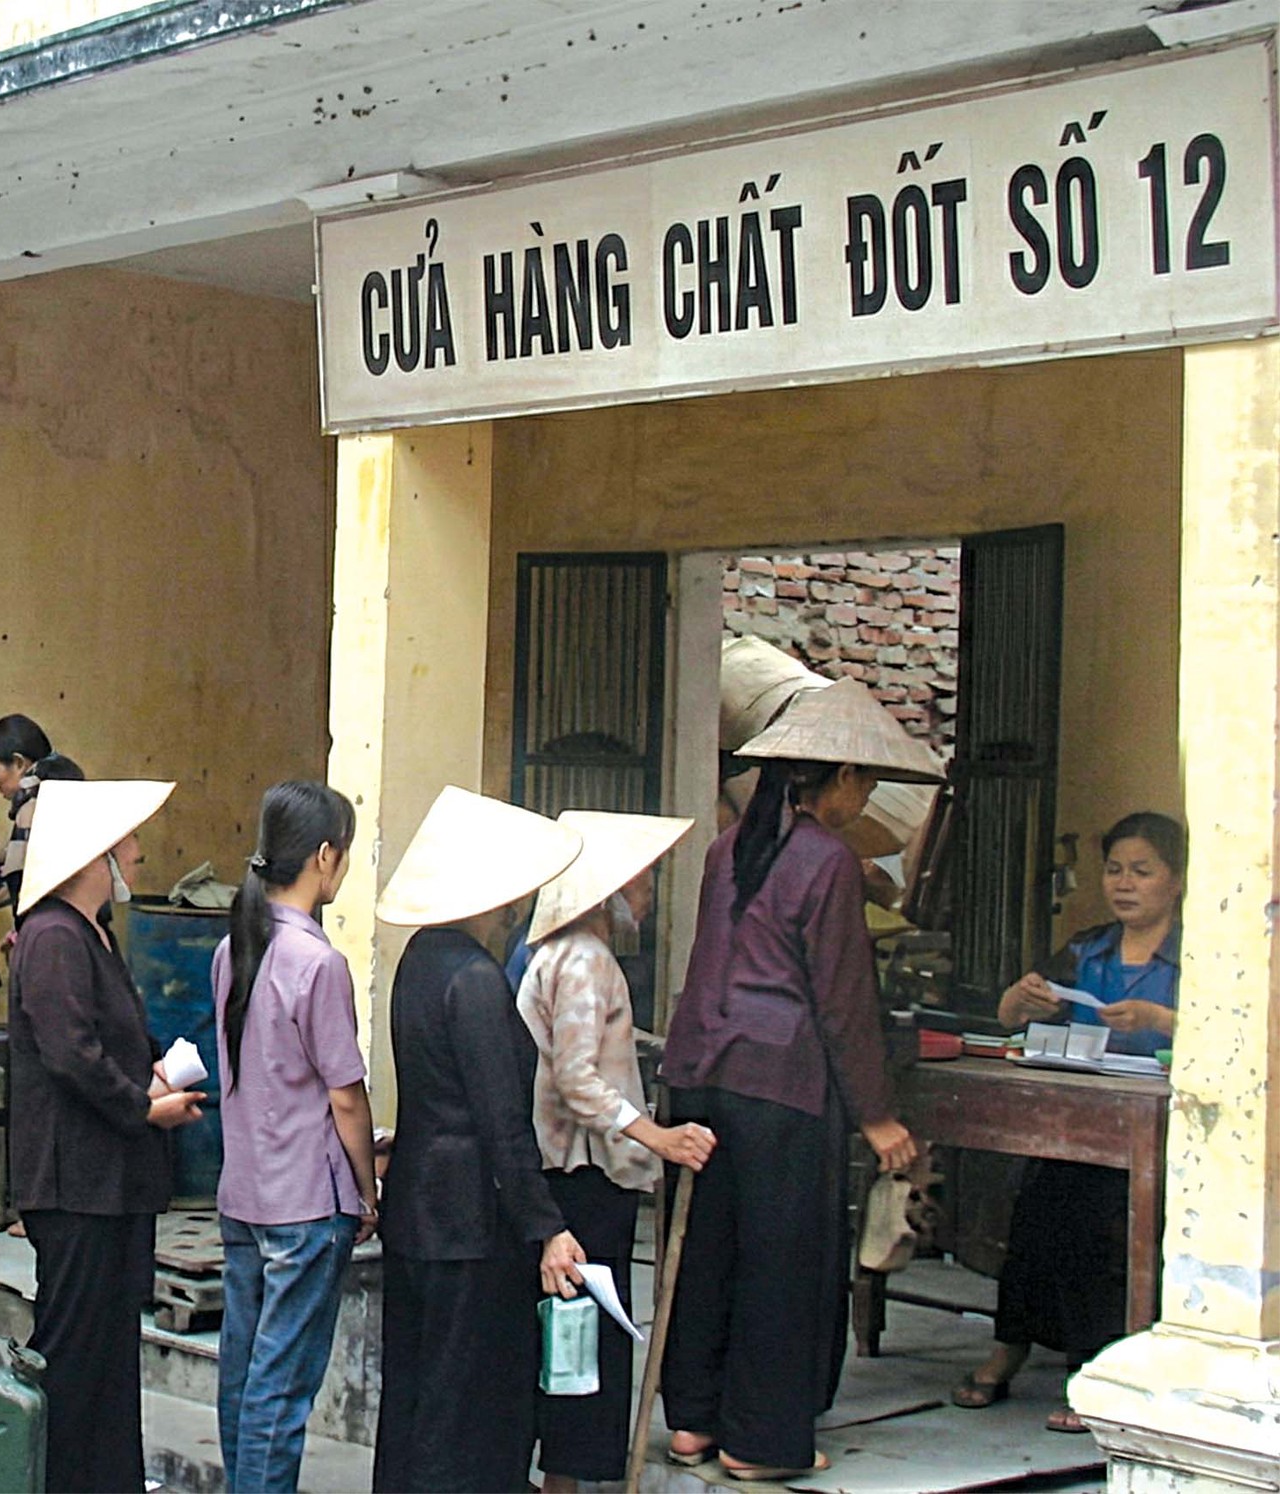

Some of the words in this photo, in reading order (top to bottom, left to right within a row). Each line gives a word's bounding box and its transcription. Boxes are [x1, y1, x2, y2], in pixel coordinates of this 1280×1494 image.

[483, 221, 631, 362] HÀNG
[663, 173, 802, 340] CHẤT
[845, 142, 967, 317] ĐỐT
[1008, 109, 1108, 295] SỐ
[1138, 133, 1230, 275] 12
